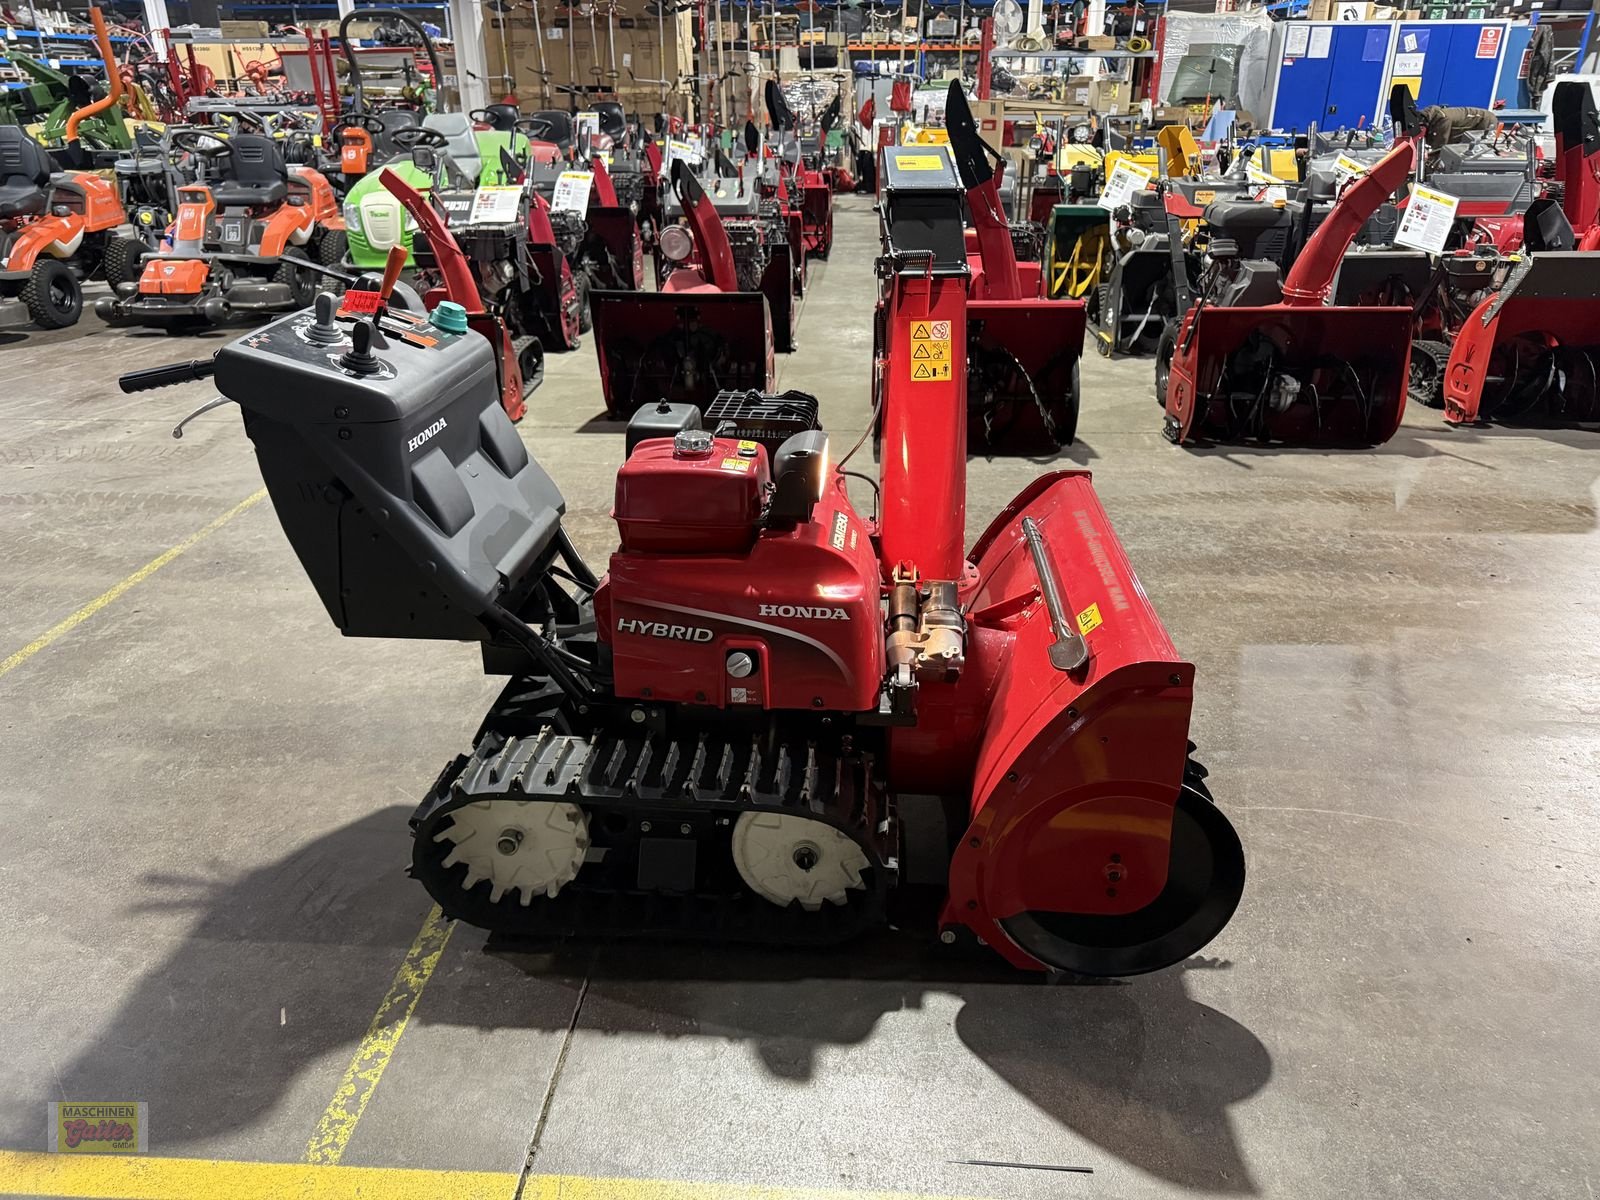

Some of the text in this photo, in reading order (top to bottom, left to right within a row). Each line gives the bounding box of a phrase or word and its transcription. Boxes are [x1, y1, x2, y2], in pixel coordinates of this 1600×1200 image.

[407, 417, 448, 452] HONDA
[758, 604, 851, 620] HONDA
[617, 618, 714, 642] HYBRID
